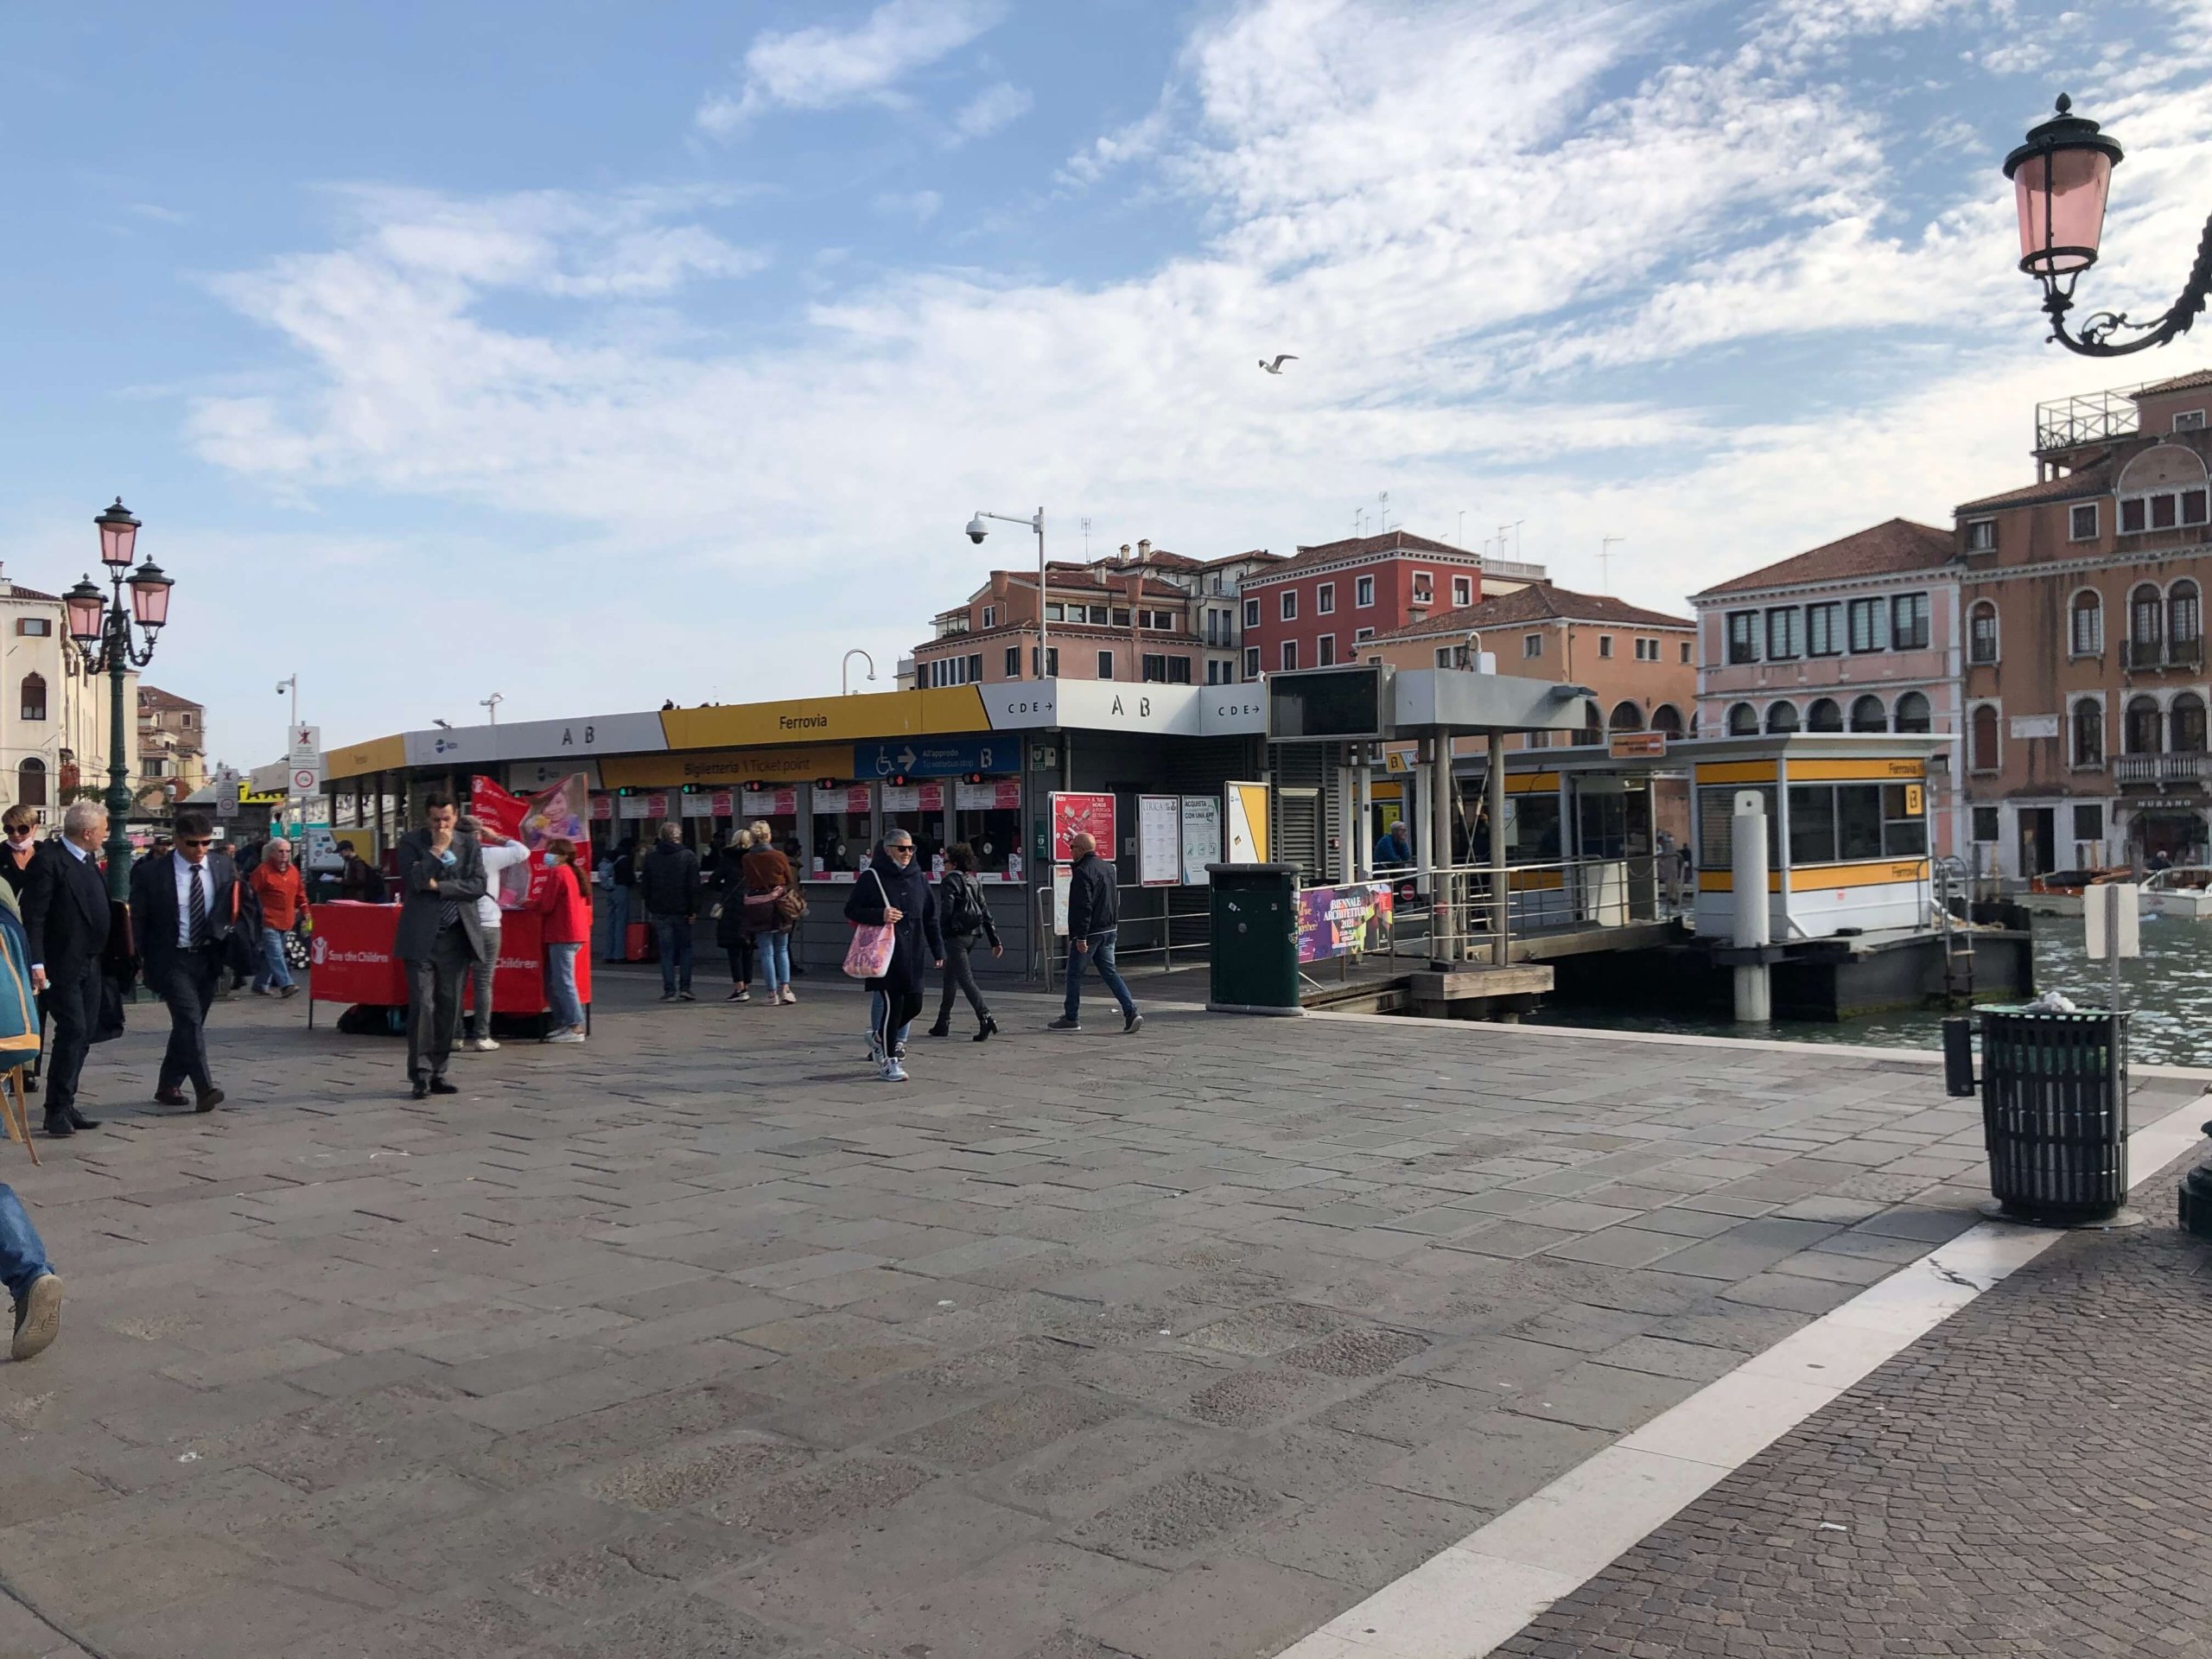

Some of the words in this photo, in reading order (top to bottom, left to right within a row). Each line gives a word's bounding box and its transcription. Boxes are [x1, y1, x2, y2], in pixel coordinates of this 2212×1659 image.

[1111, 694, 1124, 715] A
[1140, 696, 1150, 717] B
[779, 713, 827, 729] Ferrovia
[562, 728, 573, 746] A
[585, 726, 594, 744] B
[981, 747, 992, 768] B
[684, 760, 739, 778] Biglietteria
[751, 757, 781, 773] Ticket
[783, 756, 810, 774] point
[2137, 799, 2191, 808] MURANO
[1331, 897, 1361, 910] BIENNALE
[1341, 918, 1354, 929] 2021
[345, 951, 357, 962] the
[358, 951, 388, 963] Children
